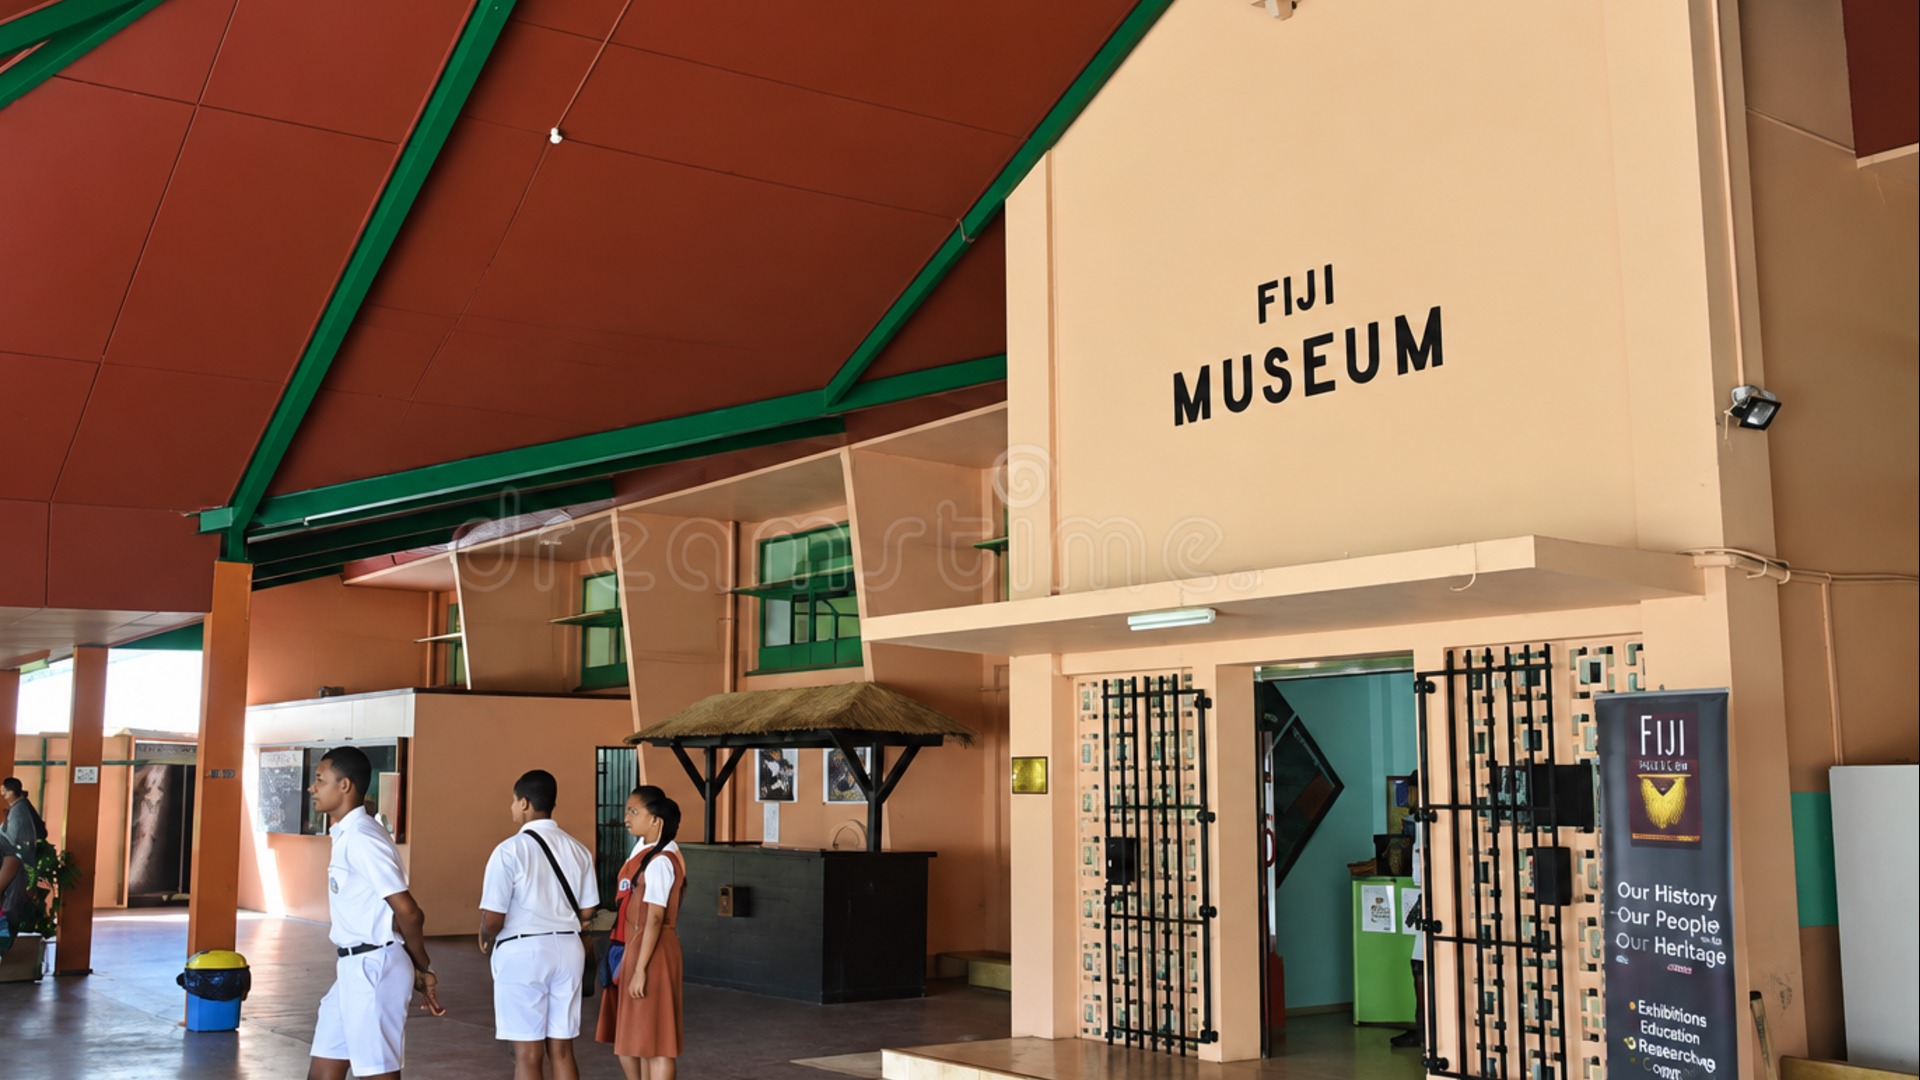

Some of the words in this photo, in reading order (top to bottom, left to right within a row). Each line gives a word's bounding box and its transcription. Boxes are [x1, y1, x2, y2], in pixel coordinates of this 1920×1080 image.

[1257, 263, 1335, 325] FIJI
[1173, 305, 1444, 427] MUSEUM
[1640, 714, 1686, 757] FIJI
[1617, 881, 1651, 901] Our
[1654, 883, 1718, 912] History
[1617, 905, 1651, 926] Our
[1655, 909, 1720, 938] People
[1615, 932, 1650, 952] Our
[1654, 935, 1727, 969] Heritage
[1638, 999, 1708, 1029] Exhibitions
[1640, 1019, 1701, 1046] Education
